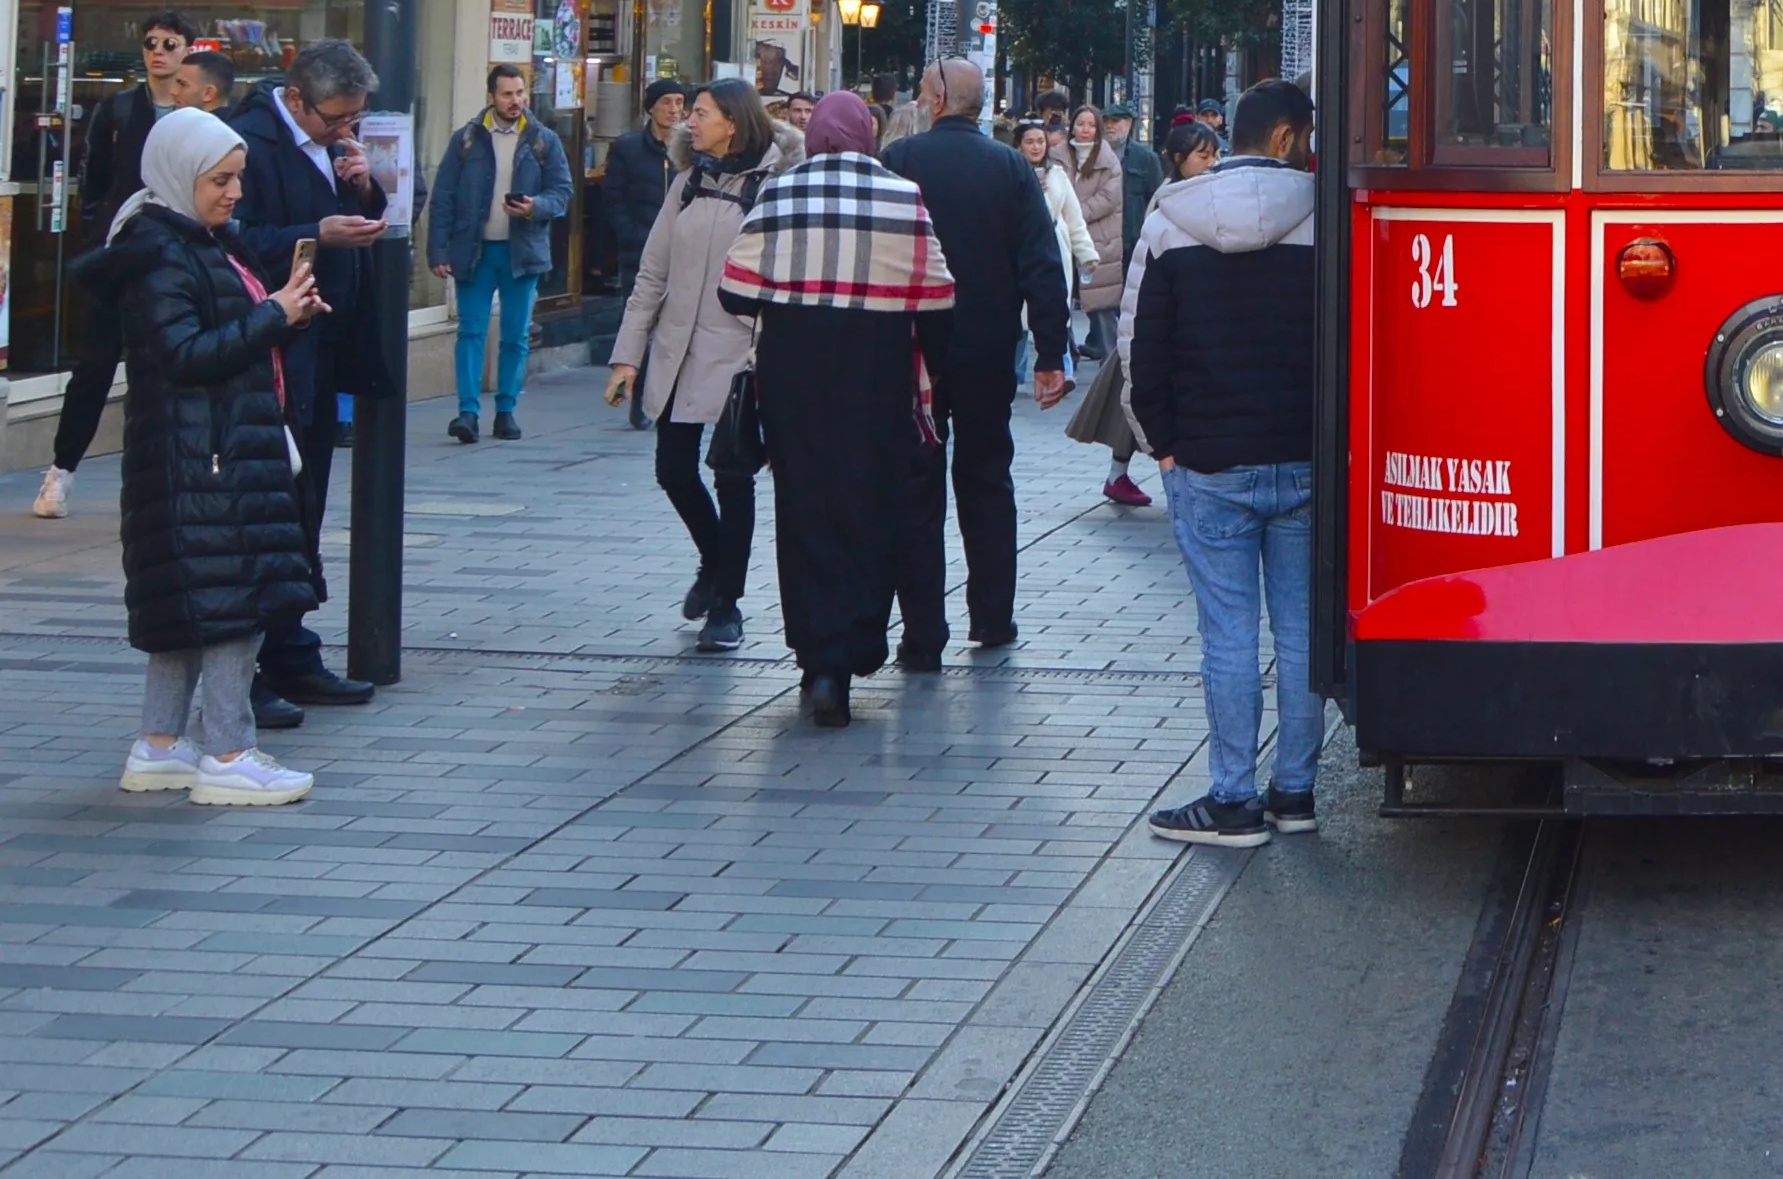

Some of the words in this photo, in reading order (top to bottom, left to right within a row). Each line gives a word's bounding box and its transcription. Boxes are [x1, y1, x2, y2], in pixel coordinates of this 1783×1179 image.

[492, 17, 532, 41] TERRACE
[751, 19, 799, 29] KESKİN
[1411, 233, 1459, 309] 34
[1384, 450, 1444, 492] ASILMAK
[1445, 457, 1512, 496] YASAK
[1381, 490, 1394, 526] VE
[1395, 493, 1519, 538] TEHLIKELIDIR
